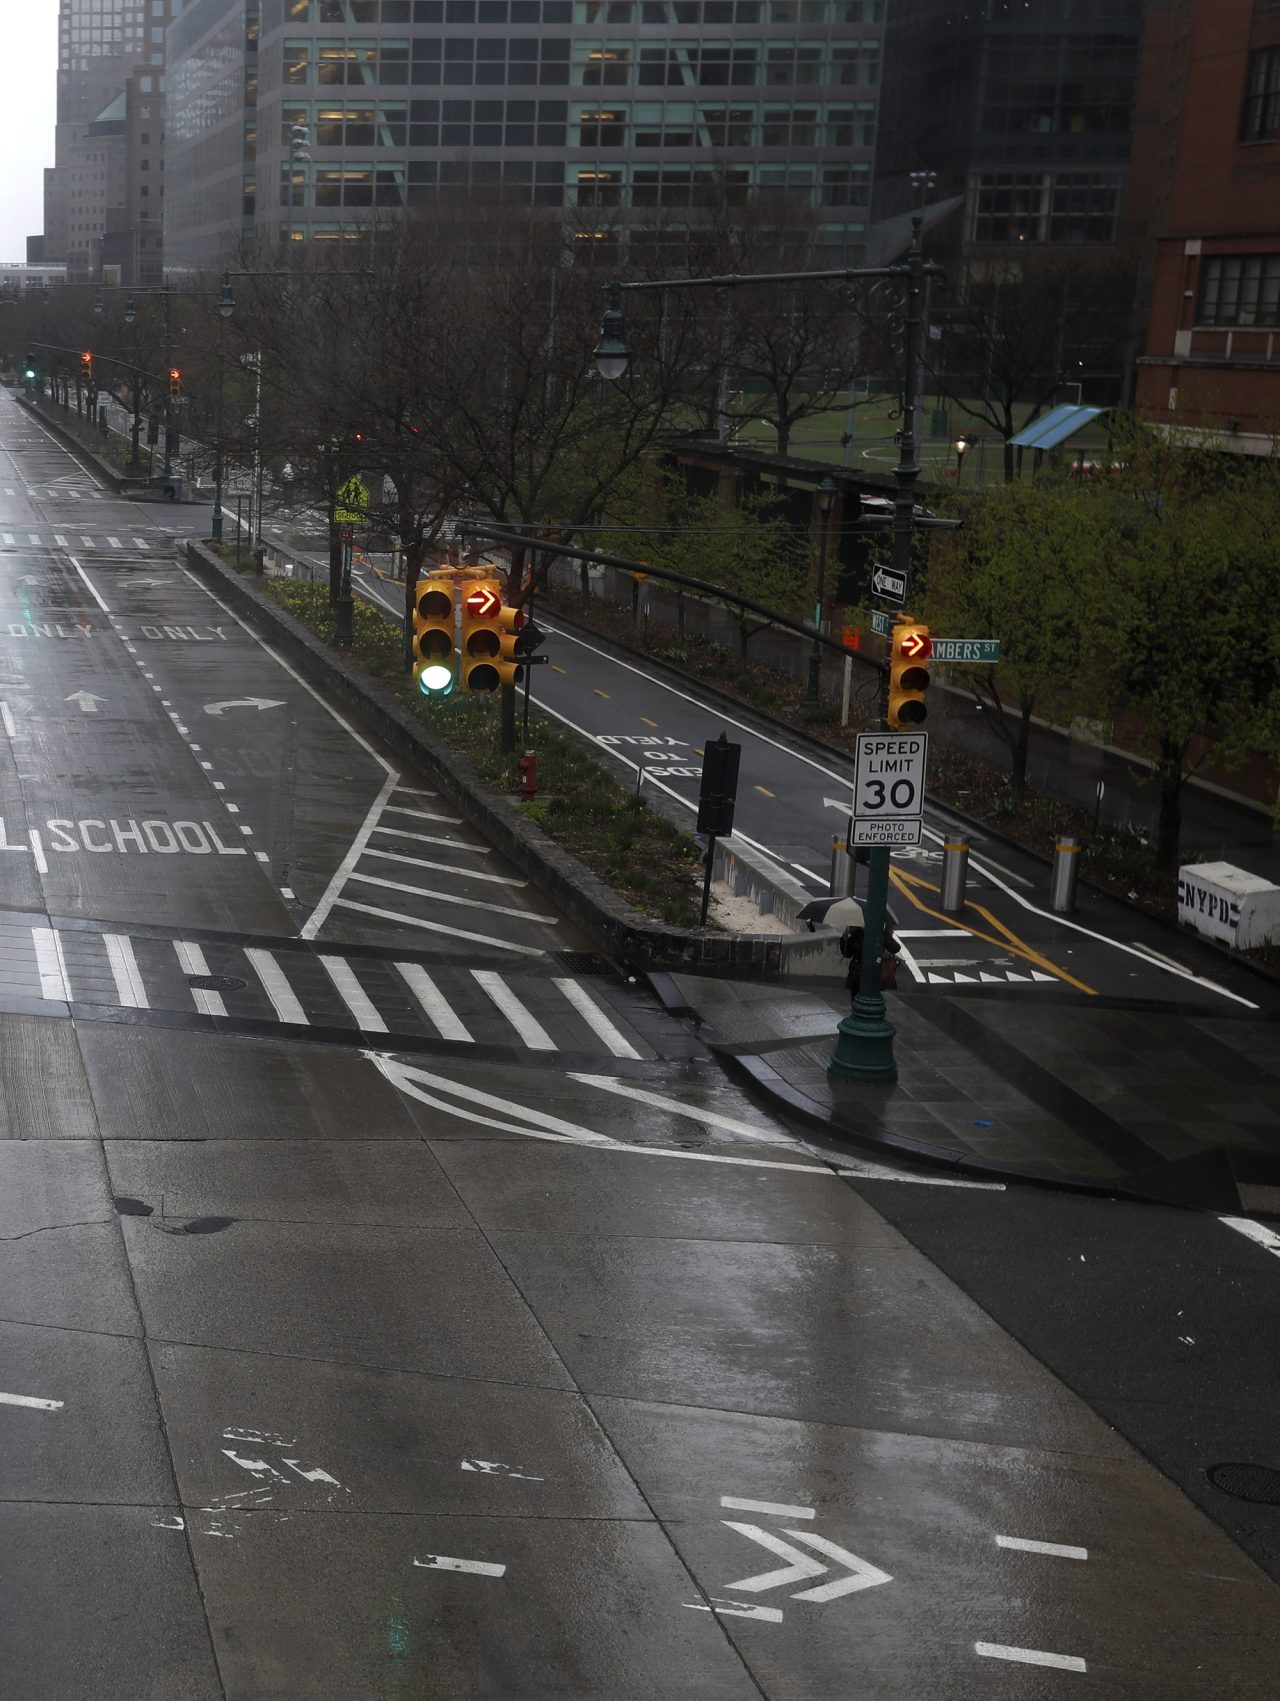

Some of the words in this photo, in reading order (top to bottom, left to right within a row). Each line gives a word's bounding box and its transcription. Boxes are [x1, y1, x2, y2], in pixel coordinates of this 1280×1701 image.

[877, 575, 887, 588] ONE
[891, 579, 903, 593] WAY
[8, 623, 92, 638] ONLY
[140, 625, 228, 640] ONLY
[984, 643, 997, 652] ST
[596, 735, 690, 746] YIELD
[643, 751, 689, 761] TO
[863, 741, 920, 756] SPEED
[869, 759, 914, 773] LIMIT
[862, 779, 915, 809] 30
[870, 823, 905, 832] PHOTO
[46, 819, 247, 855] SCHOOL
[858, 832, 915, 841] ENFORCED
[1185, 882, 1229, 924] NYPD
